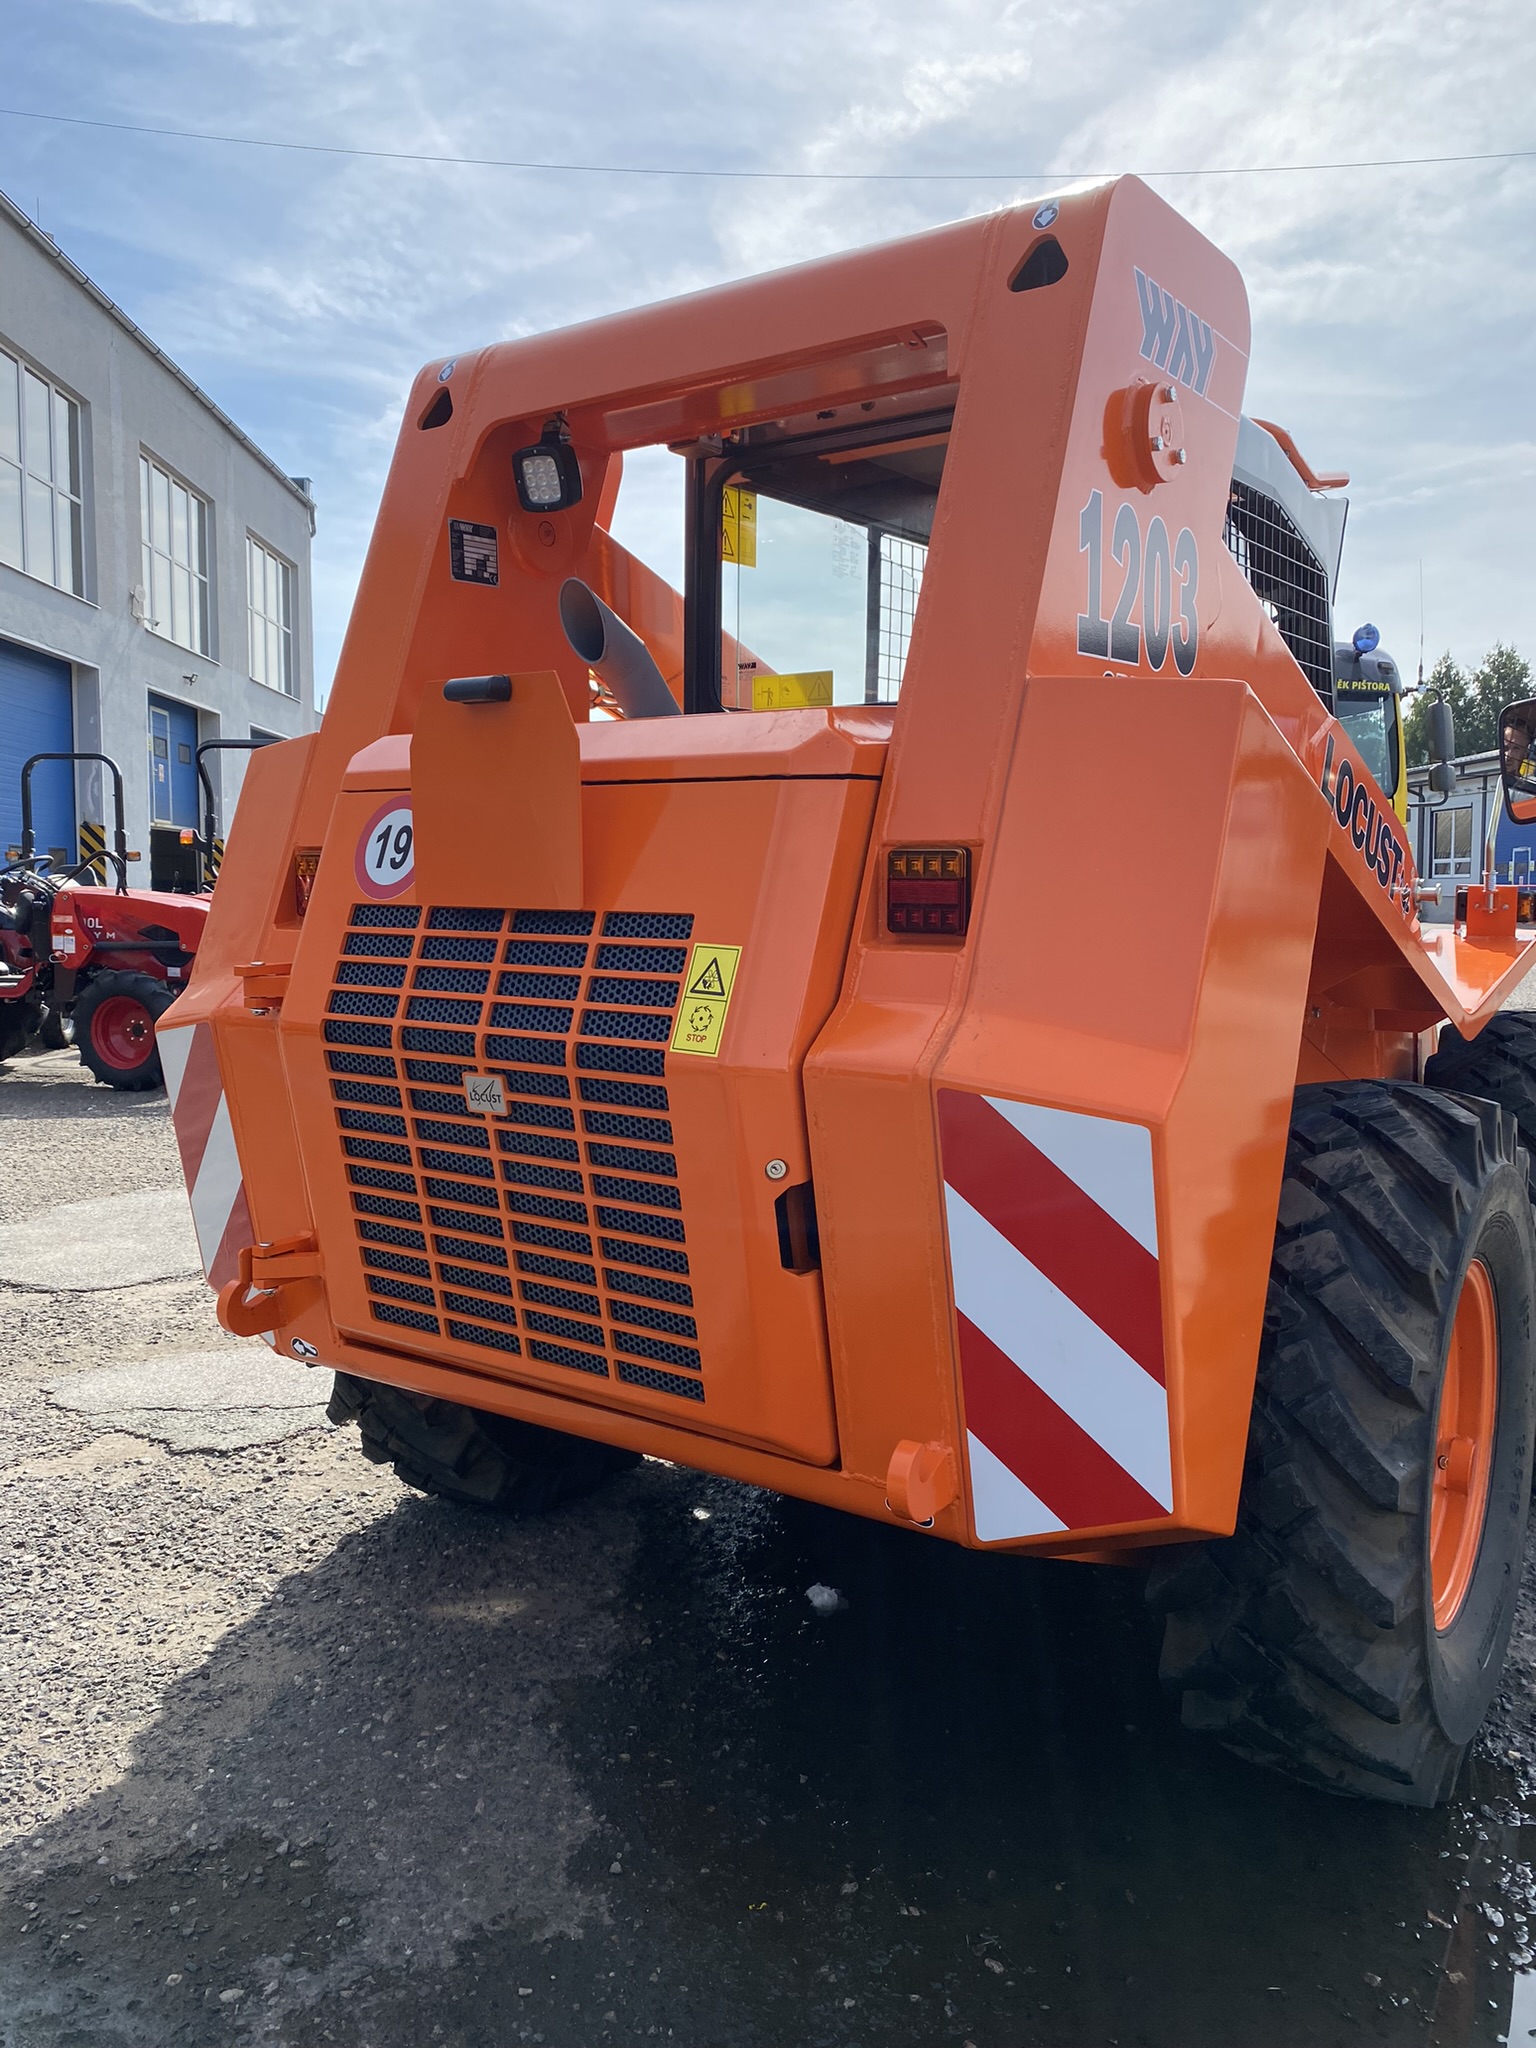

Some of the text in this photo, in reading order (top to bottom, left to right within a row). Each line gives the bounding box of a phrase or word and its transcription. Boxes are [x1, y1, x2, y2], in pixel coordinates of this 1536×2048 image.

[1134, 265, 1217, 397] WAY
[1077, 488, 1199, 678] 1203
[1352, 680, 1390, 691] PIŠTORA
[1320, 731, 1406, 903] LOCUST
[375, 824, 413, 870] 19
[686, 1033, 707, 1043] STOP
[469, 1091, 502, 1104] LOCUST
